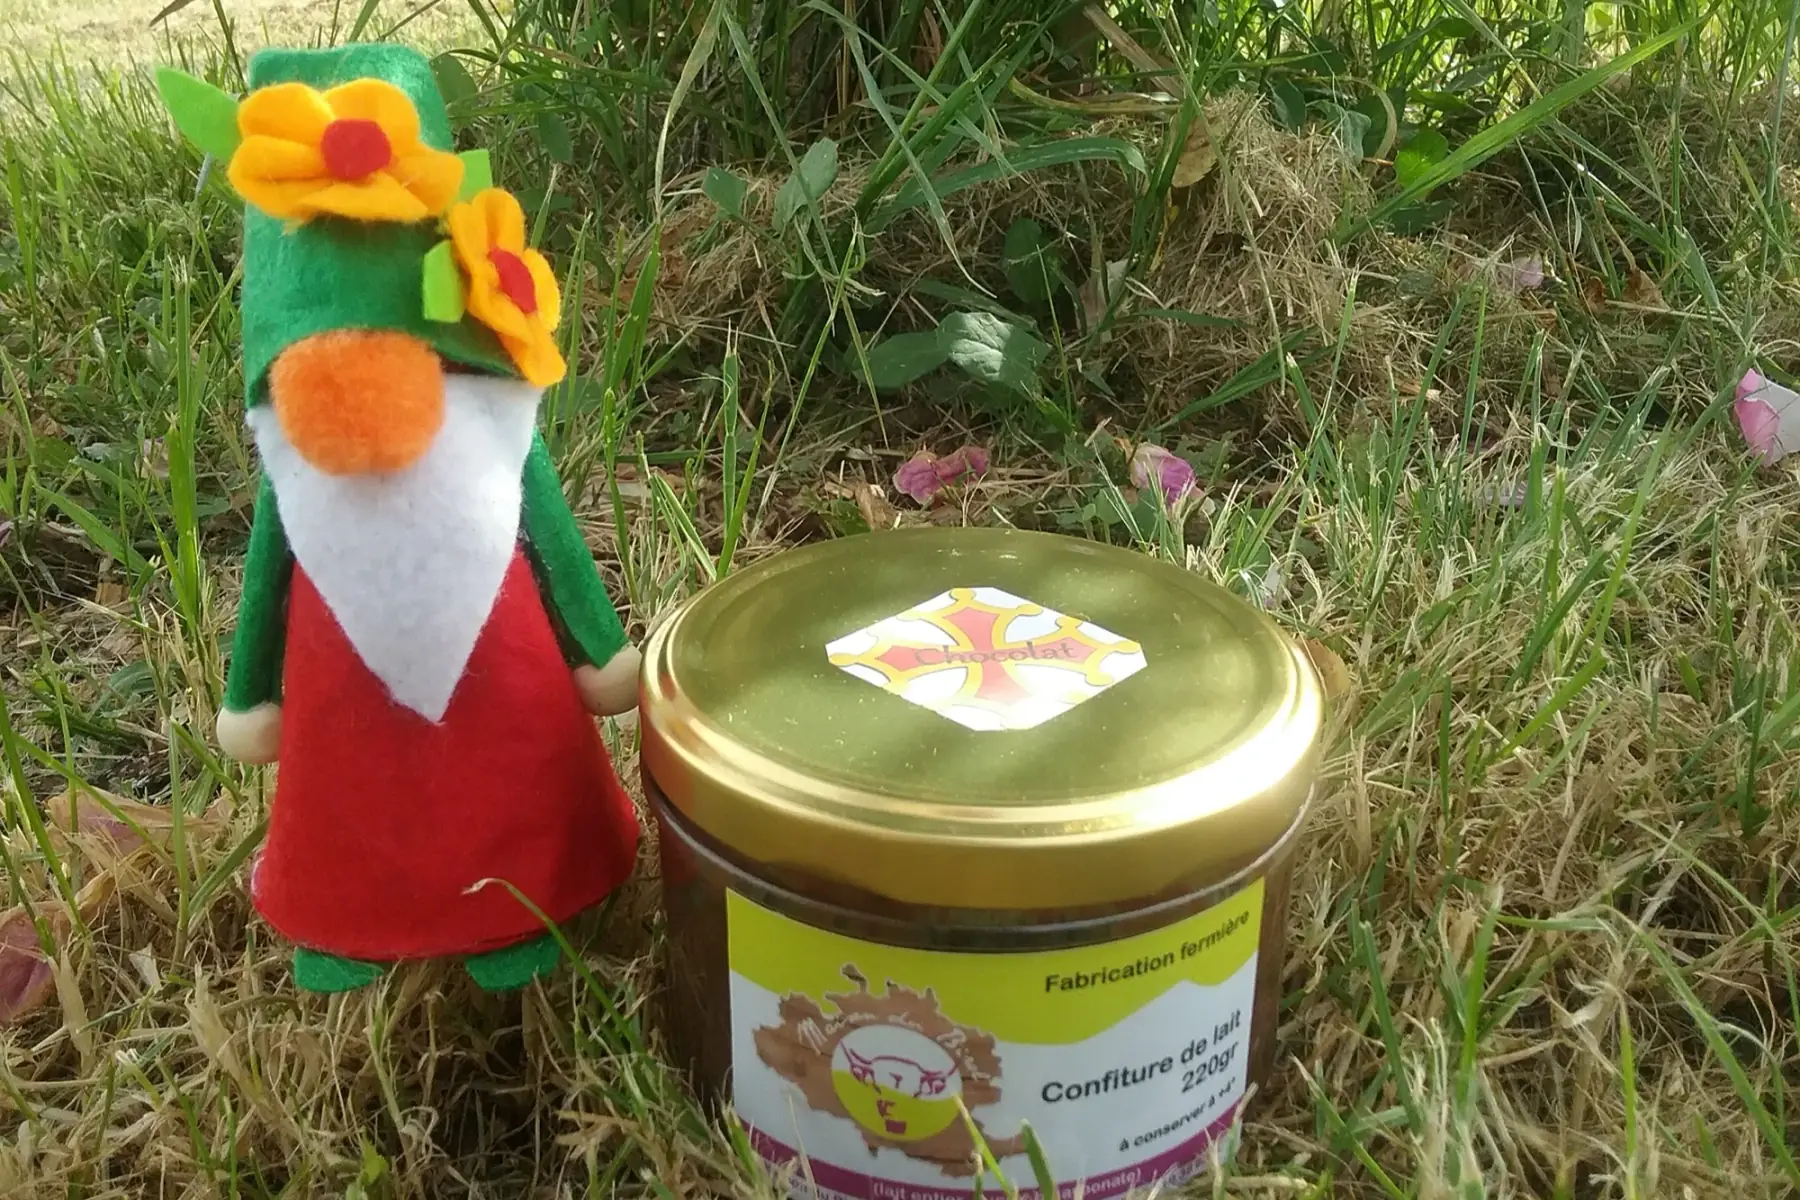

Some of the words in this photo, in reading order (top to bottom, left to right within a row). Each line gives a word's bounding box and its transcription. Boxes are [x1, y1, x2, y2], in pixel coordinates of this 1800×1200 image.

[913, 640, 1079, 666] Chocolat
[1045, 951, 1175, 993] Fabrication
[1180, 910, 1250, 961] fermière
[1041, 1055, 1174, 1103] Confiture
[1180, 1037, 1208, 1065] de
[1213, 1009, 1242, 1045] lait
[1182, 1041, 1240, 1094] 220gr
[1133, 1102, 1206, 1147] conserver
